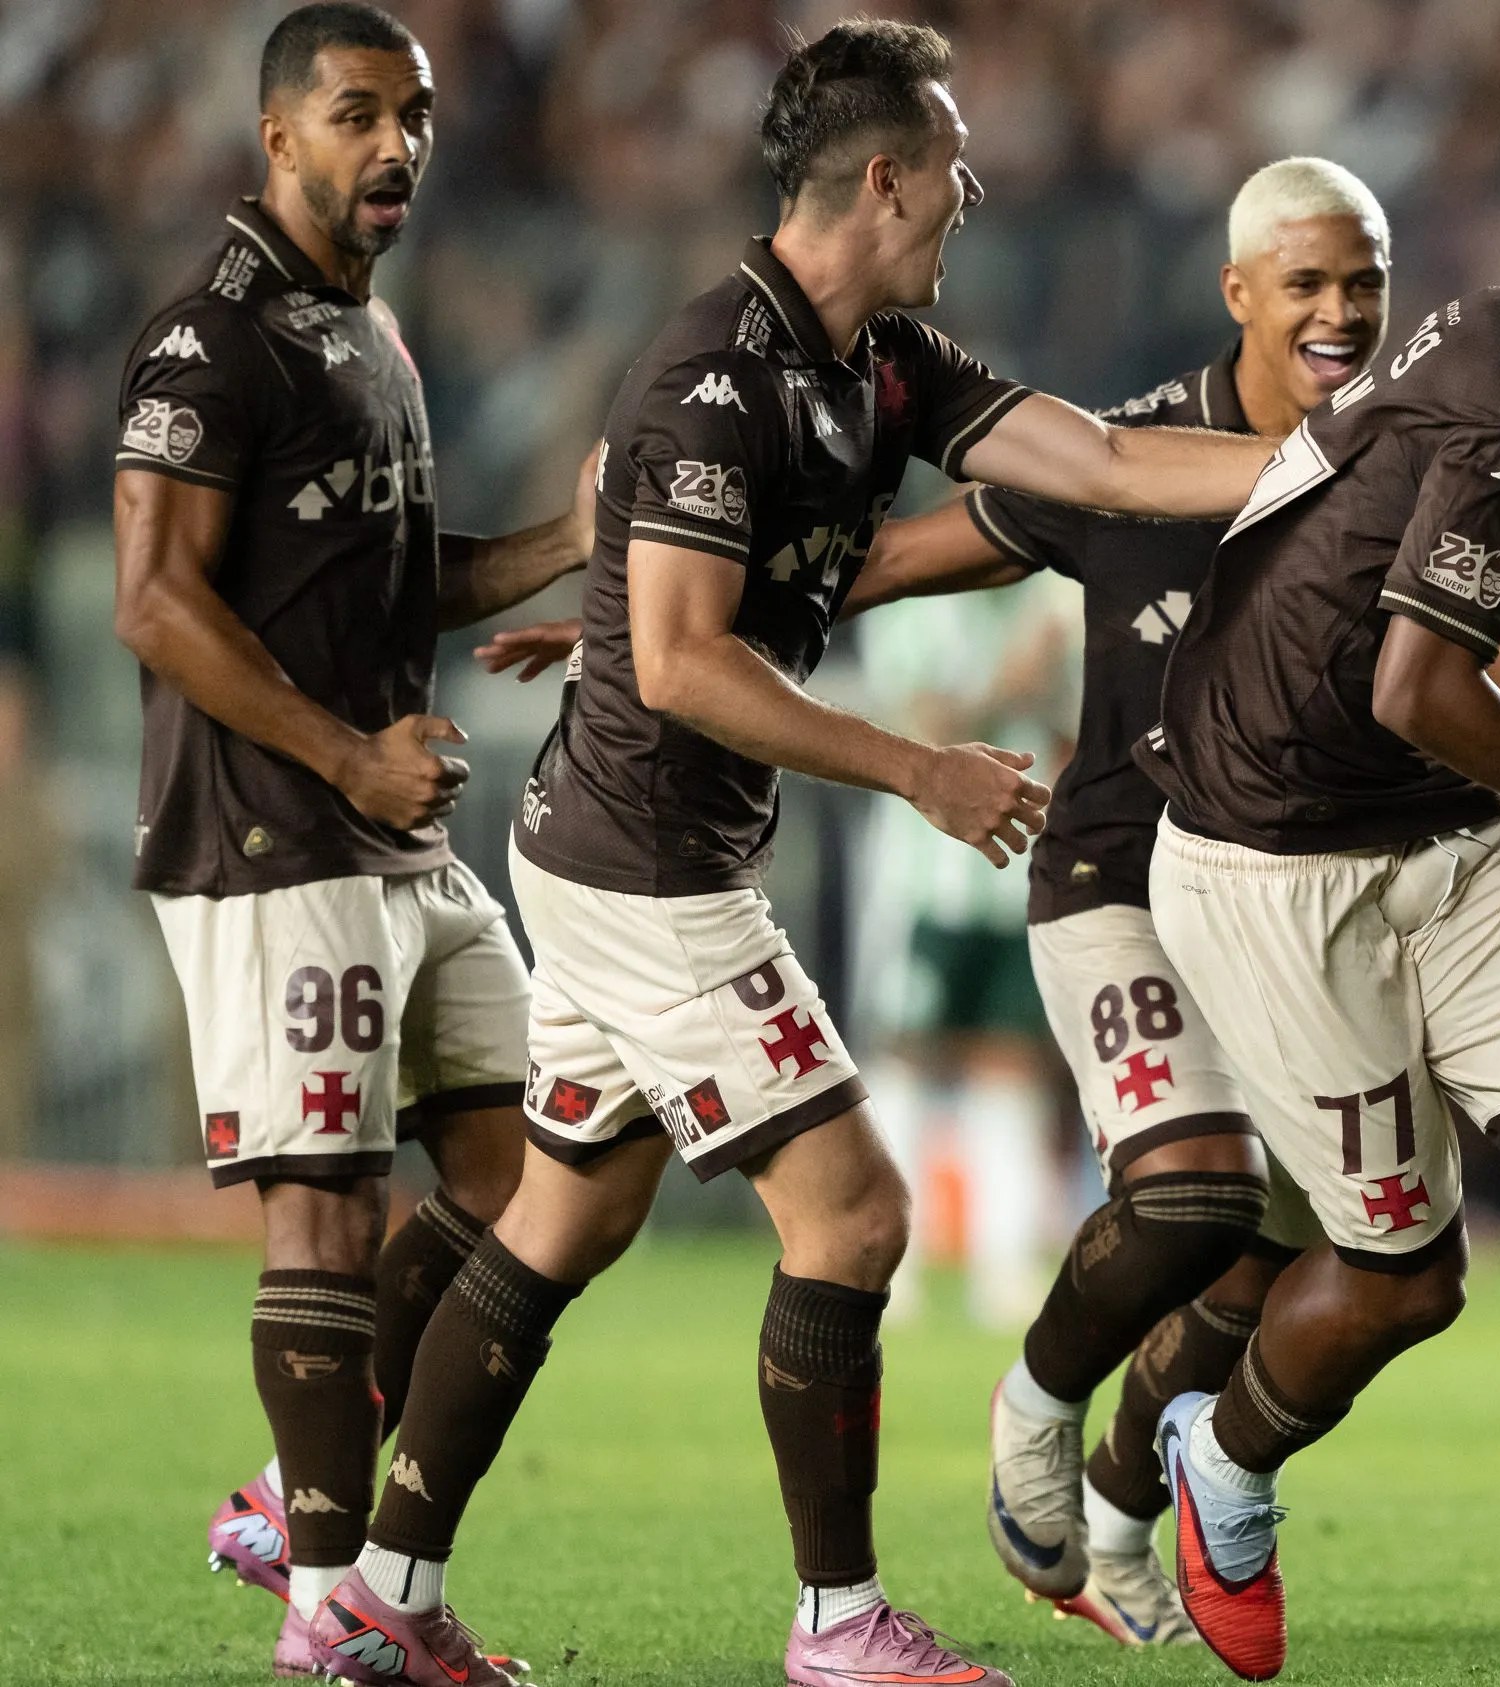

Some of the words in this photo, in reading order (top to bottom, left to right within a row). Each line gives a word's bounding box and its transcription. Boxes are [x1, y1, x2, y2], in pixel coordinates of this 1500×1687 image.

[737, 307, 754, 334] MOTO
[673, 463, 718, 503] Zé
[670, 500, 717, 516] DELIVERY
[1432, 533, 1482, 582] Zé
[1424, 568, 1471, 595] DELIVERY
[285, 963, 385, 1054] 96
[1090, 975, 1184, 1064] 88
[1313, 1068, 1416, 1176] 77
